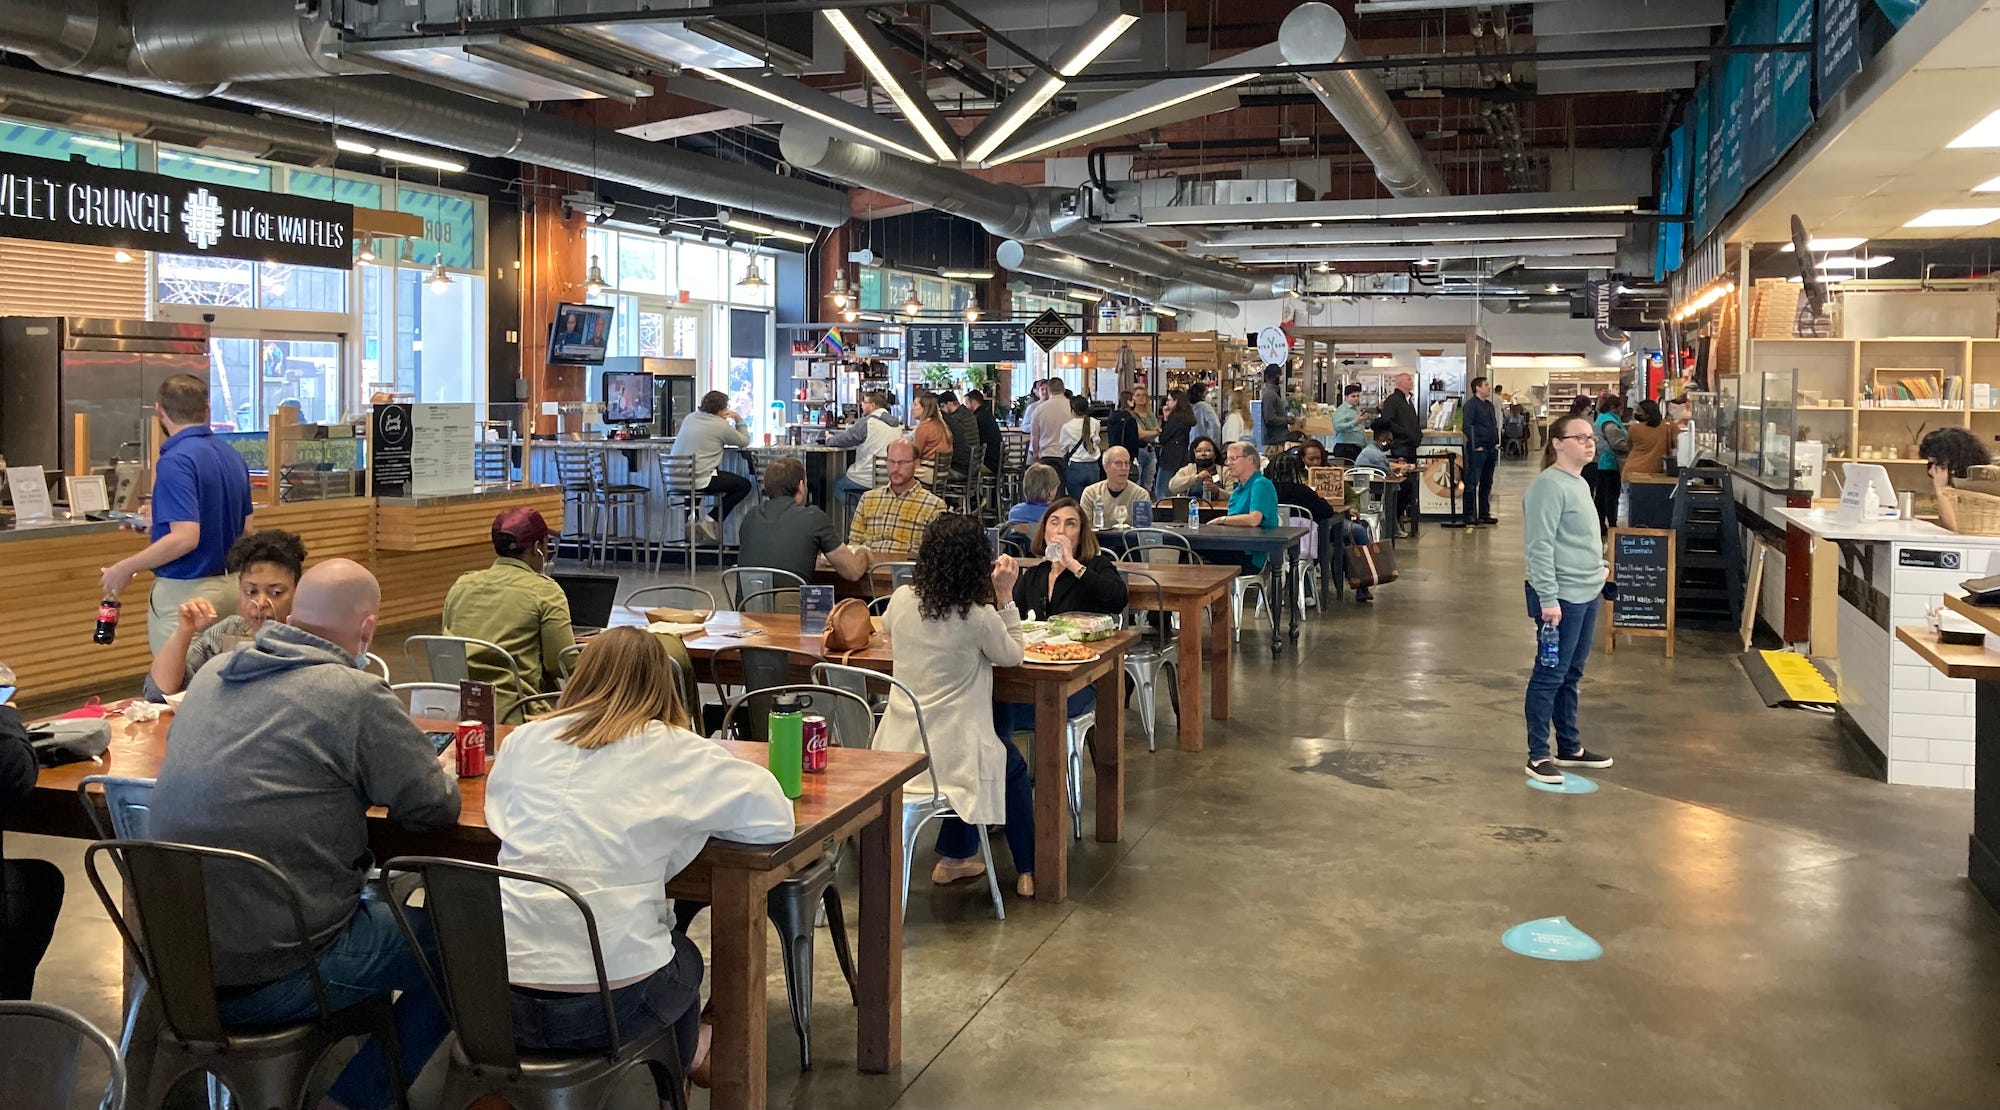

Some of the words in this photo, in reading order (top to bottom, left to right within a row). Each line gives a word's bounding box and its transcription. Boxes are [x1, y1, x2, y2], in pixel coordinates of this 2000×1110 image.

[69, 183, 170, 233] CRUNCH
[278, 215, 344, 249] WAFFLES
[1597, 283, 1609, 329] VALIDATE
[1030, 327, 1066, 335] COFFEE
